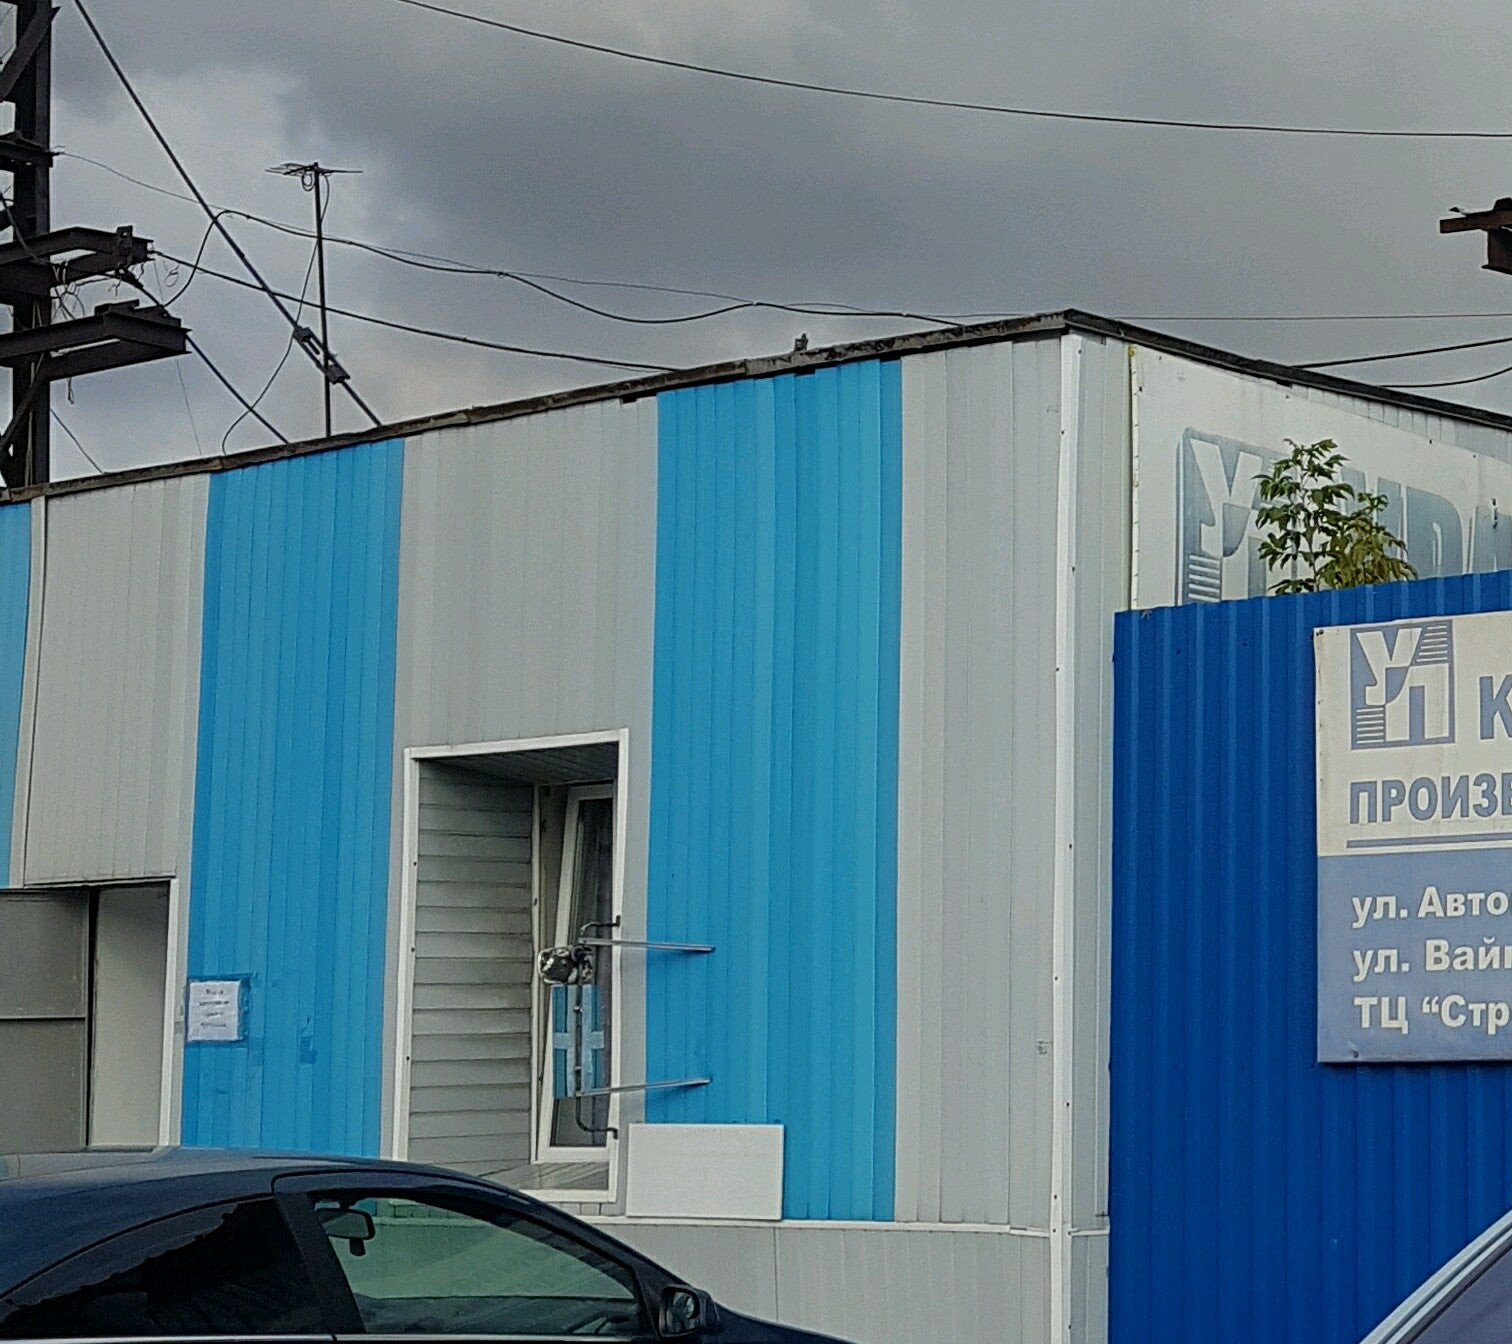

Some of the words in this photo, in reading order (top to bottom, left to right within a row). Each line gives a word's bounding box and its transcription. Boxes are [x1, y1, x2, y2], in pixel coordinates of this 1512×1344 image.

[1351, 895, 1408, 929] ул.
[1352, 949, 1410, 983] ул.
[1354, 997, 1408, 1035] ТЦ
